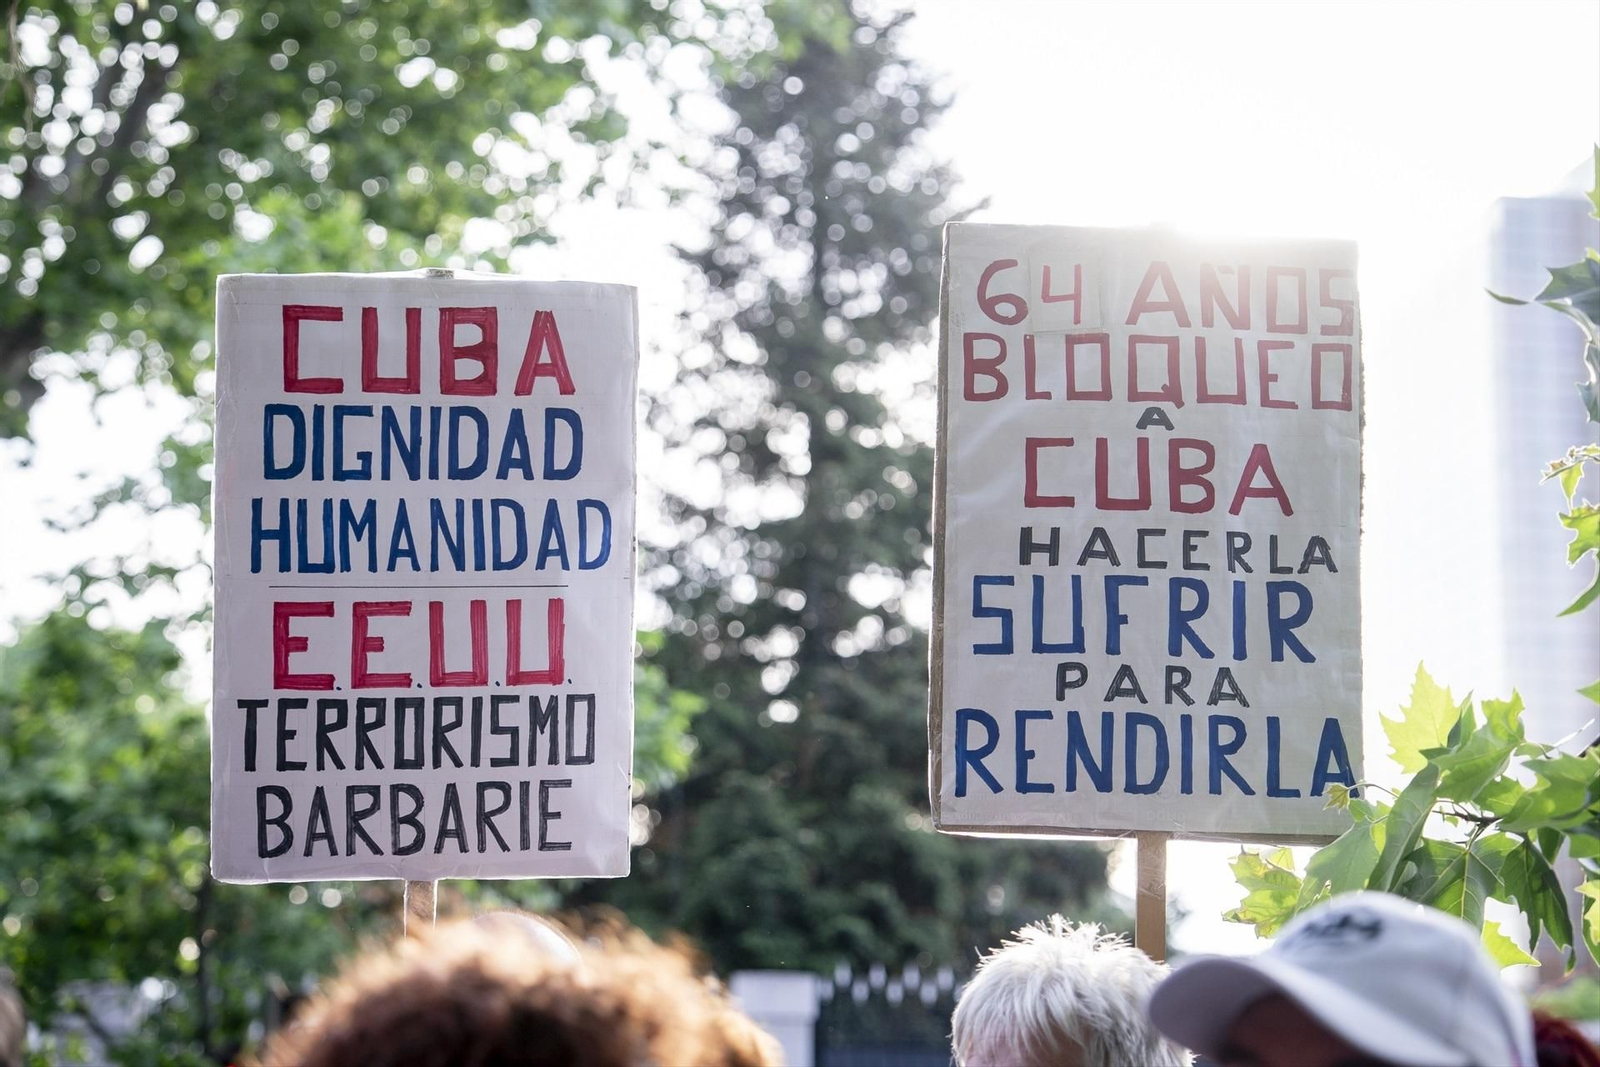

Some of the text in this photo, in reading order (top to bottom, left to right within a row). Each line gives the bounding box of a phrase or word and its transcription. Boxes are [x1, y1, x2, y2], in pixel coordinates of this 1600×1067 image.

[977, 258, 1354, 336] 64 AÑOS
[282, 304, 576, 396] CUBA
[963, 332, 1353, 412] BLOQUEO
[263, 403, 584, 482] DIGNIDAD
[1135, 406, 1175, 431] A
[1023, 436, 1294, 517] CUBA
[250, 497, 612, 574] HUMANIDAD
[1019, 526, 1338, 574] HACERLA
[273, 597, 572, 691] E.E.U.U.
[972, 574, 1317, 663] SUFRIR
[1055, 661, 1250, 708] PARA
[237, 693, 596, 772] TERRORISMO
[955, 708, 1360, 798] RENDIRLA
[257, 779, 572, 859] BARBARIE
